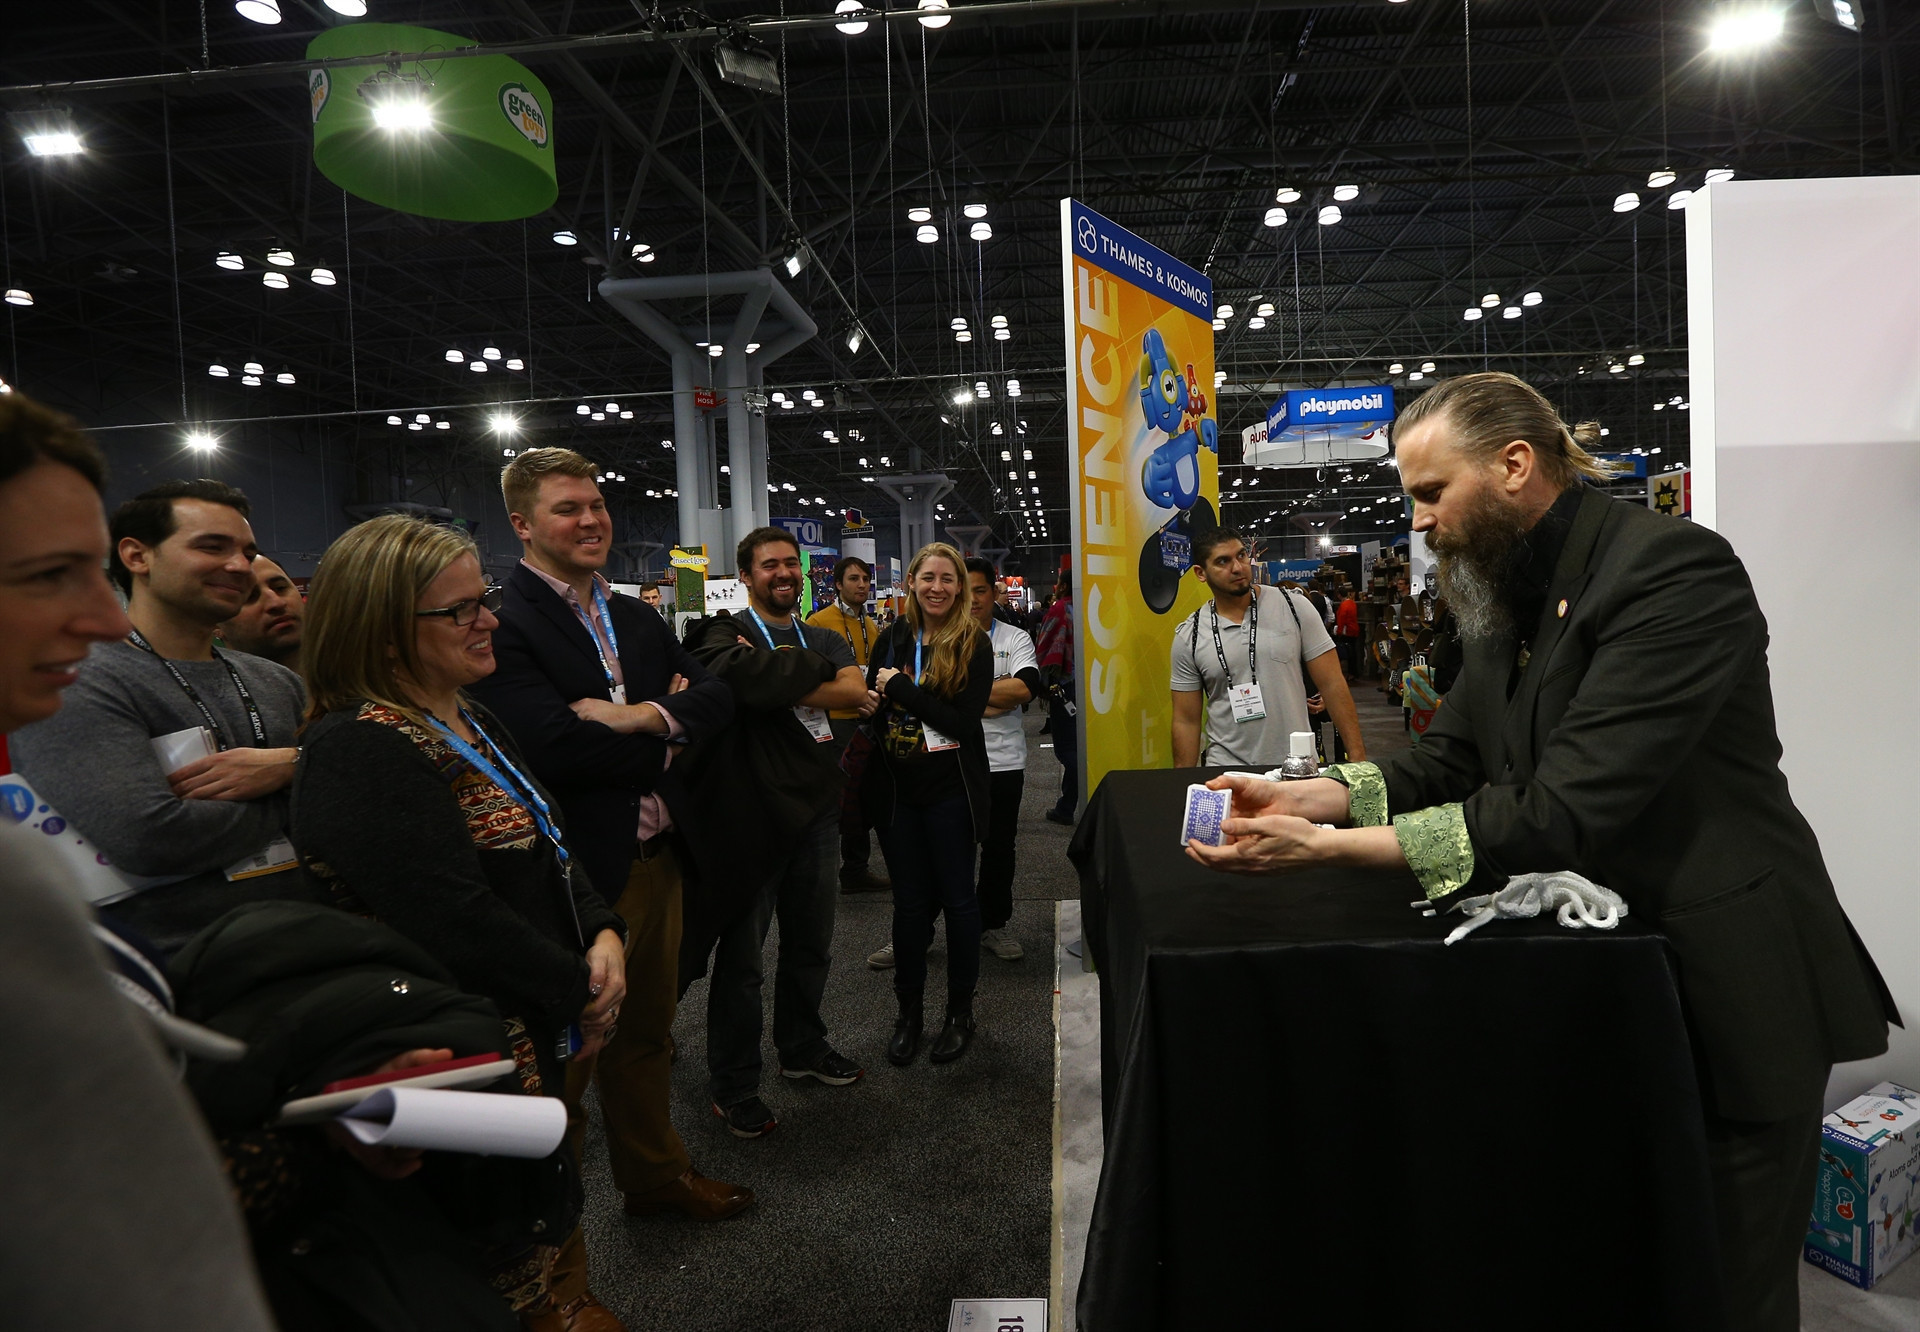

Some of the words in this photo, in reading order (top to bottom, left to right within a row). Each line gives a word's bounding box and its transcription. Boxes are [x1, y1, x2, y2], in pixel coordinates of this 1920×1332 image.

[509, 93, 543, 127] green
[522, 112, 544, 139] toys
[1101, 235, 1153, 278] THAMES
[1156, 267, 1164, 284] &
[1167, 272, 1207, 307] KOSMOS
[697, 397, 714, 405] HOSE
[1300, 394, 1383, 417] playmobil
[1078, 265, 1130, 715] SCIENCE
[1660, 493, 1673, 505] ONE
[603, 614, 611, 627] FAIR
[1823, 1168, 1833, 1197] Happy
[1889, 1164, 1906, 1181] Atoms
[1822, 1196, 1832, 1222] Atoms
[1825, 1256, 1861, 1276] THAMES
[1826, 1263, 1861, 1283] KOSMOS
